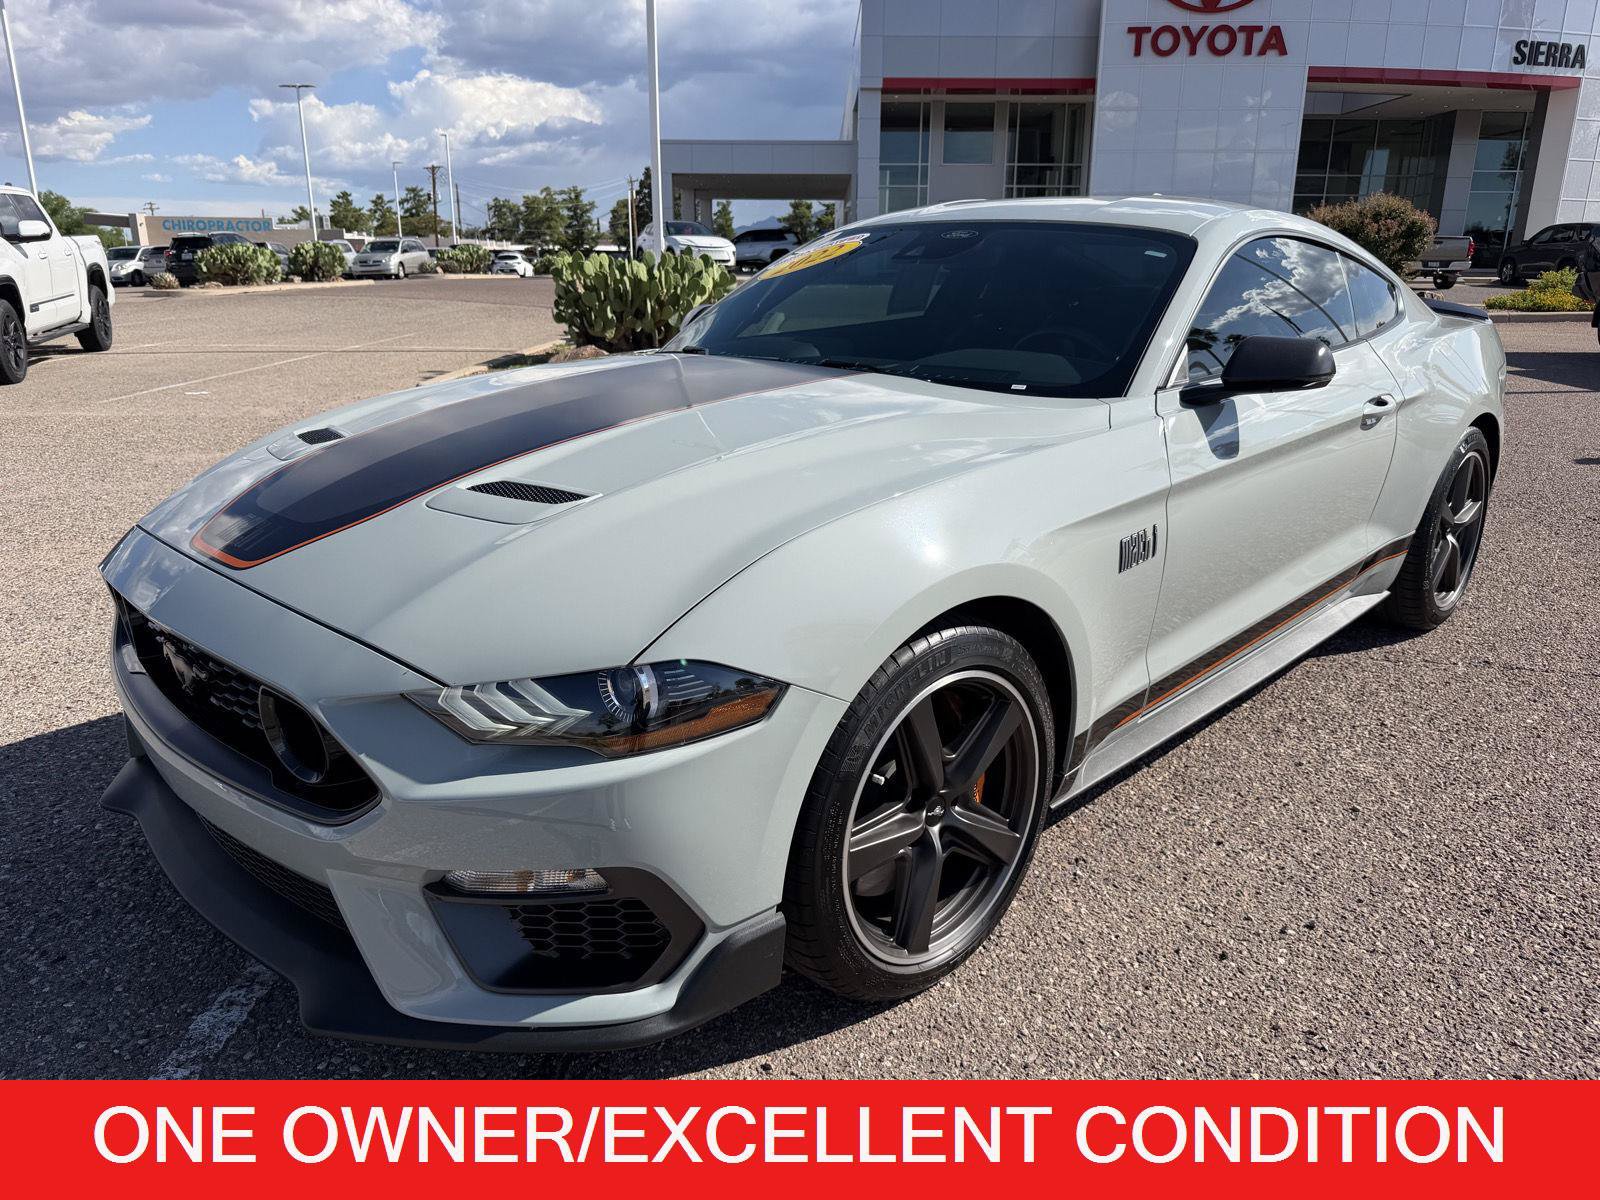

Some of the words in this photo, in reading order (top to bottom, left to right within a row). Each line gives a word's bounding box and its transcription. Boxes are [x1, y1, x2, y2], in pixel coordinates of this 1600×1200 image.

[1127, 24, 1288, 57] TOYOTA
[1512, 39, 1587, 70] SIERRA
[162, 218, 272, 232] CHIROPRACTOR
